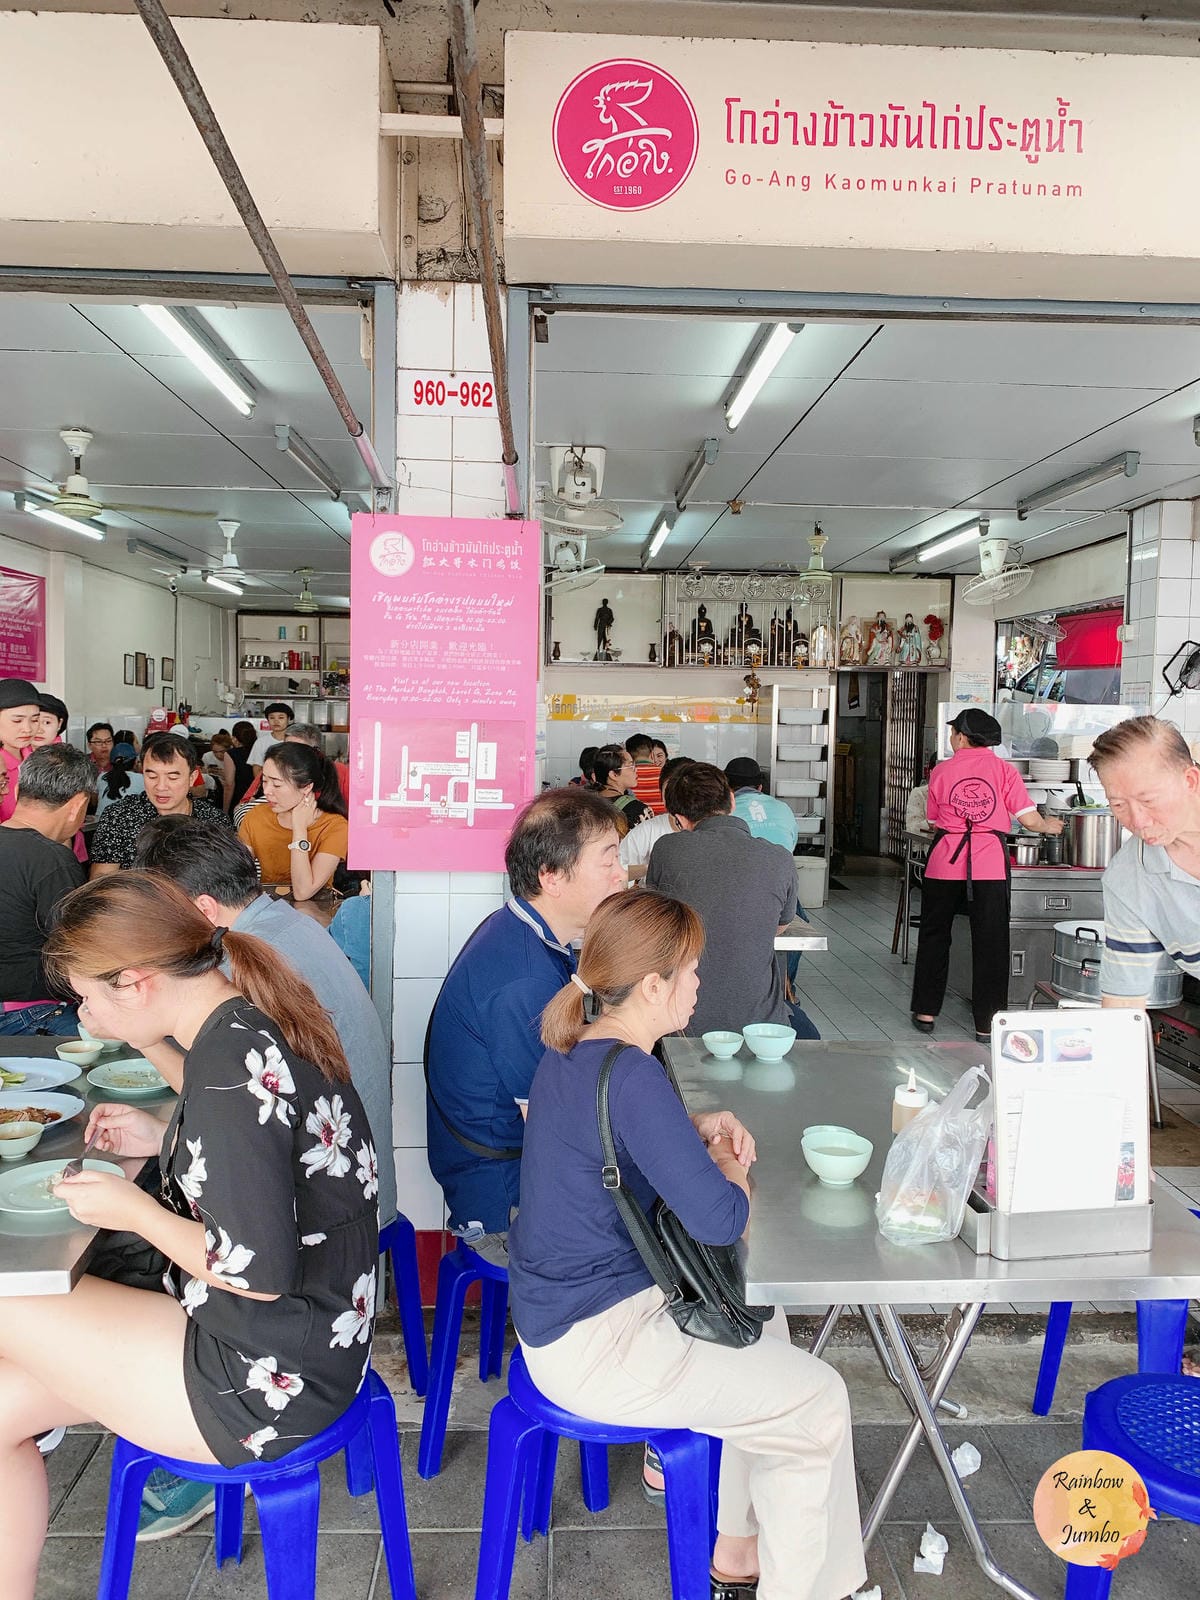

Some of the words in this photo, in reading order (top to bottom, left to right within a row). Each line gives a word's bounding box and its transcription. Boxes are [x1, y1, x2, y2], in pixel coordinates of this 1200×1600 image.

[725, 98, 1084, 163] โกอ่างข้าวมันไก่ประตูน้ำ
[624, 185, 642, 195] 1960
[725, 168, 812, 192] Go-Ang
[825, 173, 957, 194] Kaomunkai
[970, 176, 1083, 197] Pratunam
[414, 380, 493, 407] 960-962
